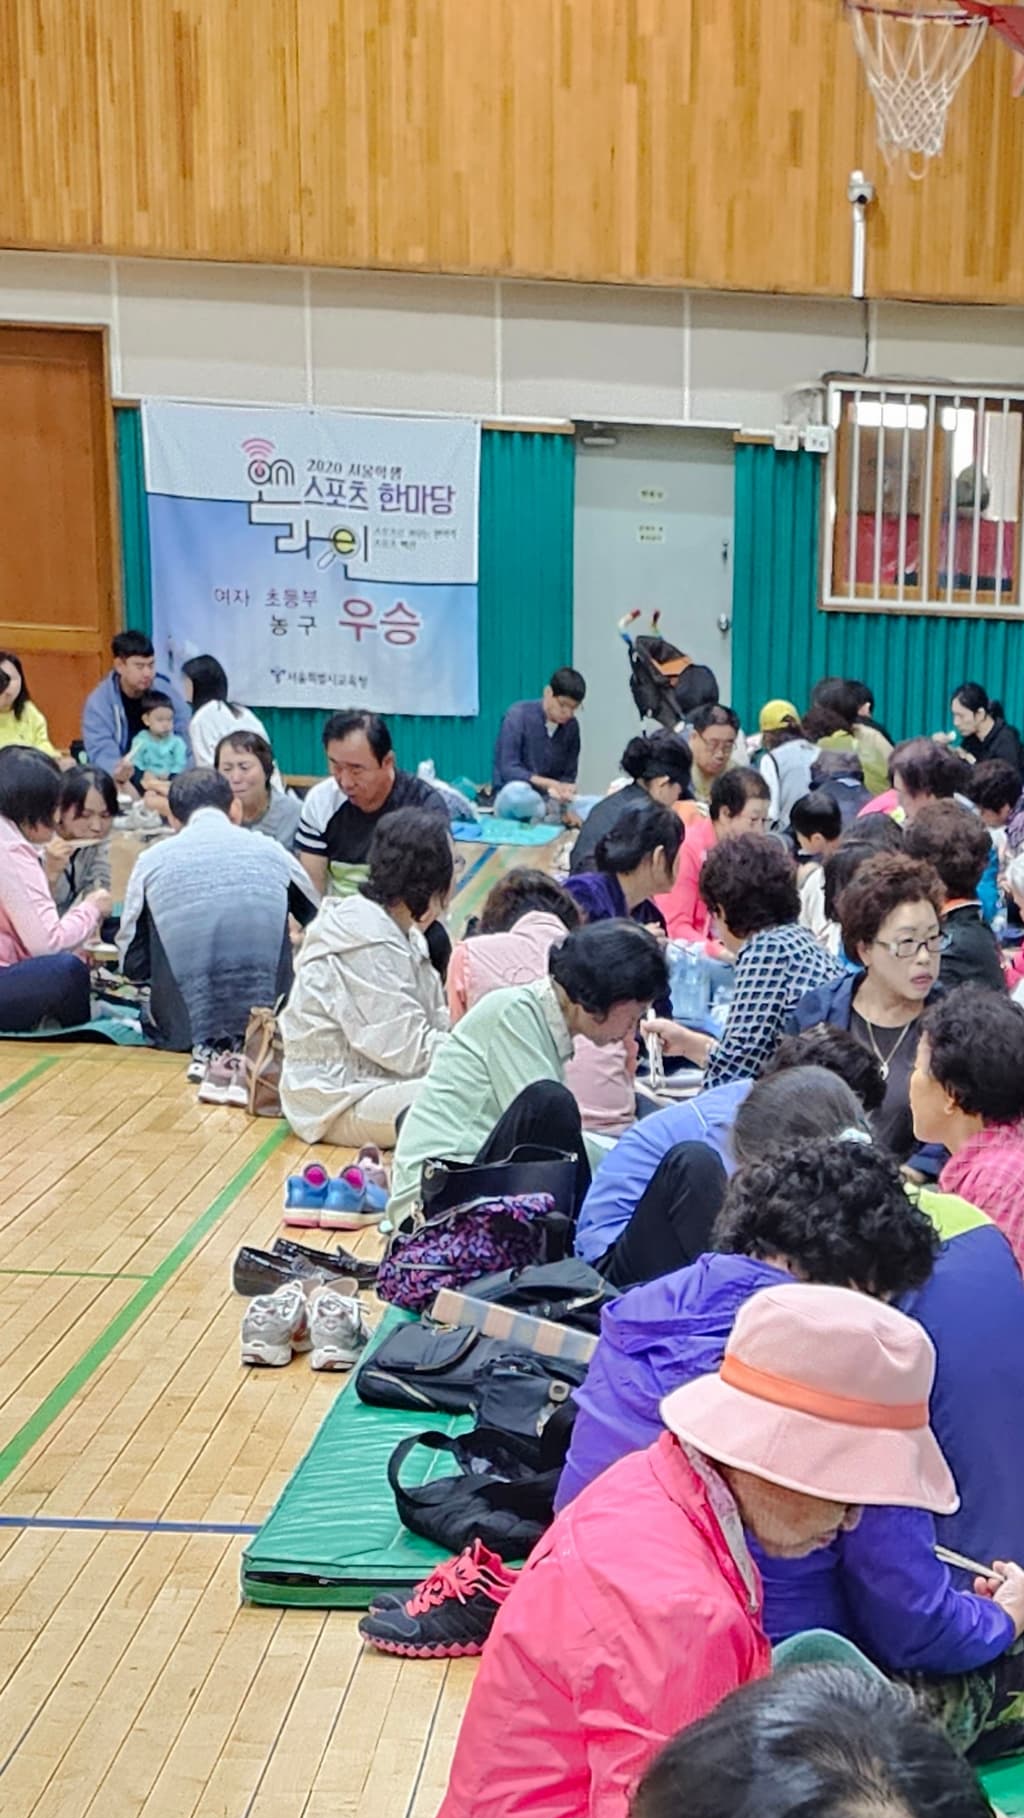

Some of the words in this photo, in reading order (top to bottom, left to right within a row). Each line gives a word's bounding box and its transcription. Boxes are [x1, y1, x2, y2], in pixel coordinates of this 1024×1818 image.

[306, 458, 343, 475] 2020
[303, 475, 369, 511] 스포츠
[377, 482, 457, 516] 한마당
[265, 587, 319, 609] 초등부
[338, 598, 421, 646] 우승
